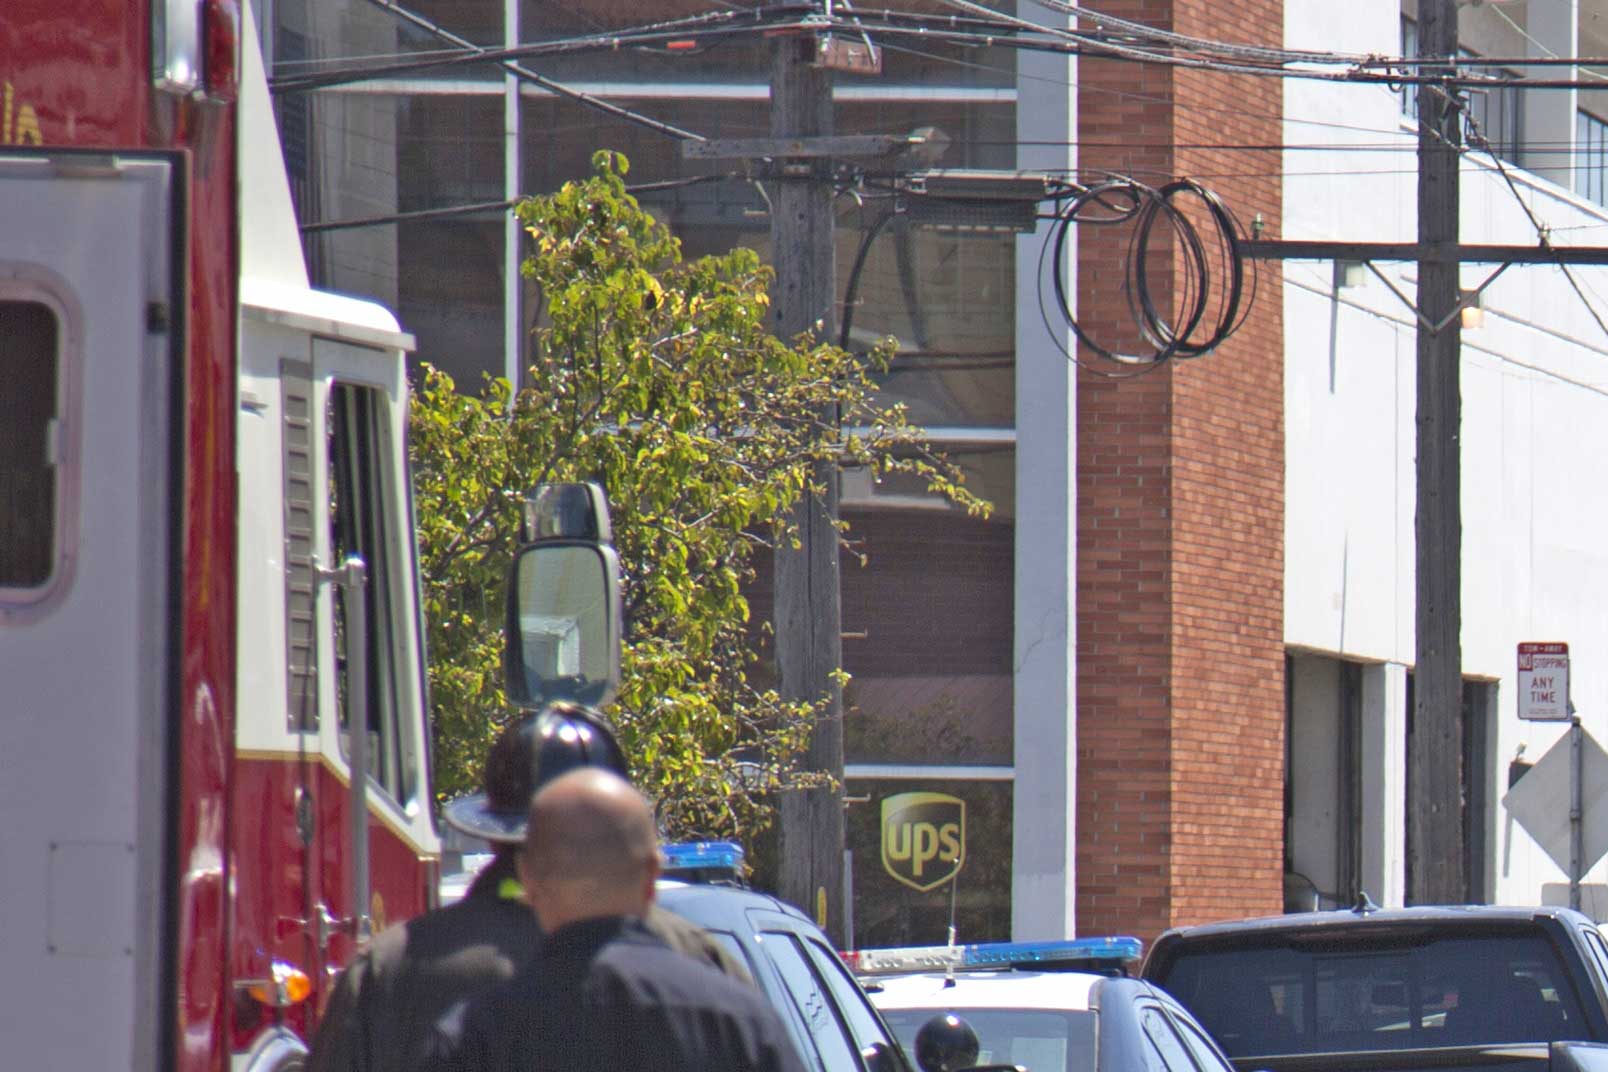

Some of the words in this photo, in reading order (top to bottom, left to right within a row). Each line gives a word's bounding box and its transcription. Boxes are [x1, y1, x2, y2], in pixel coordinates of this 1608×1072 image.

[1520, 654, 1532, 668] NO
[1531, 677, 1553, 689] ANY
[1531, 691, 1556, 703] TIME
